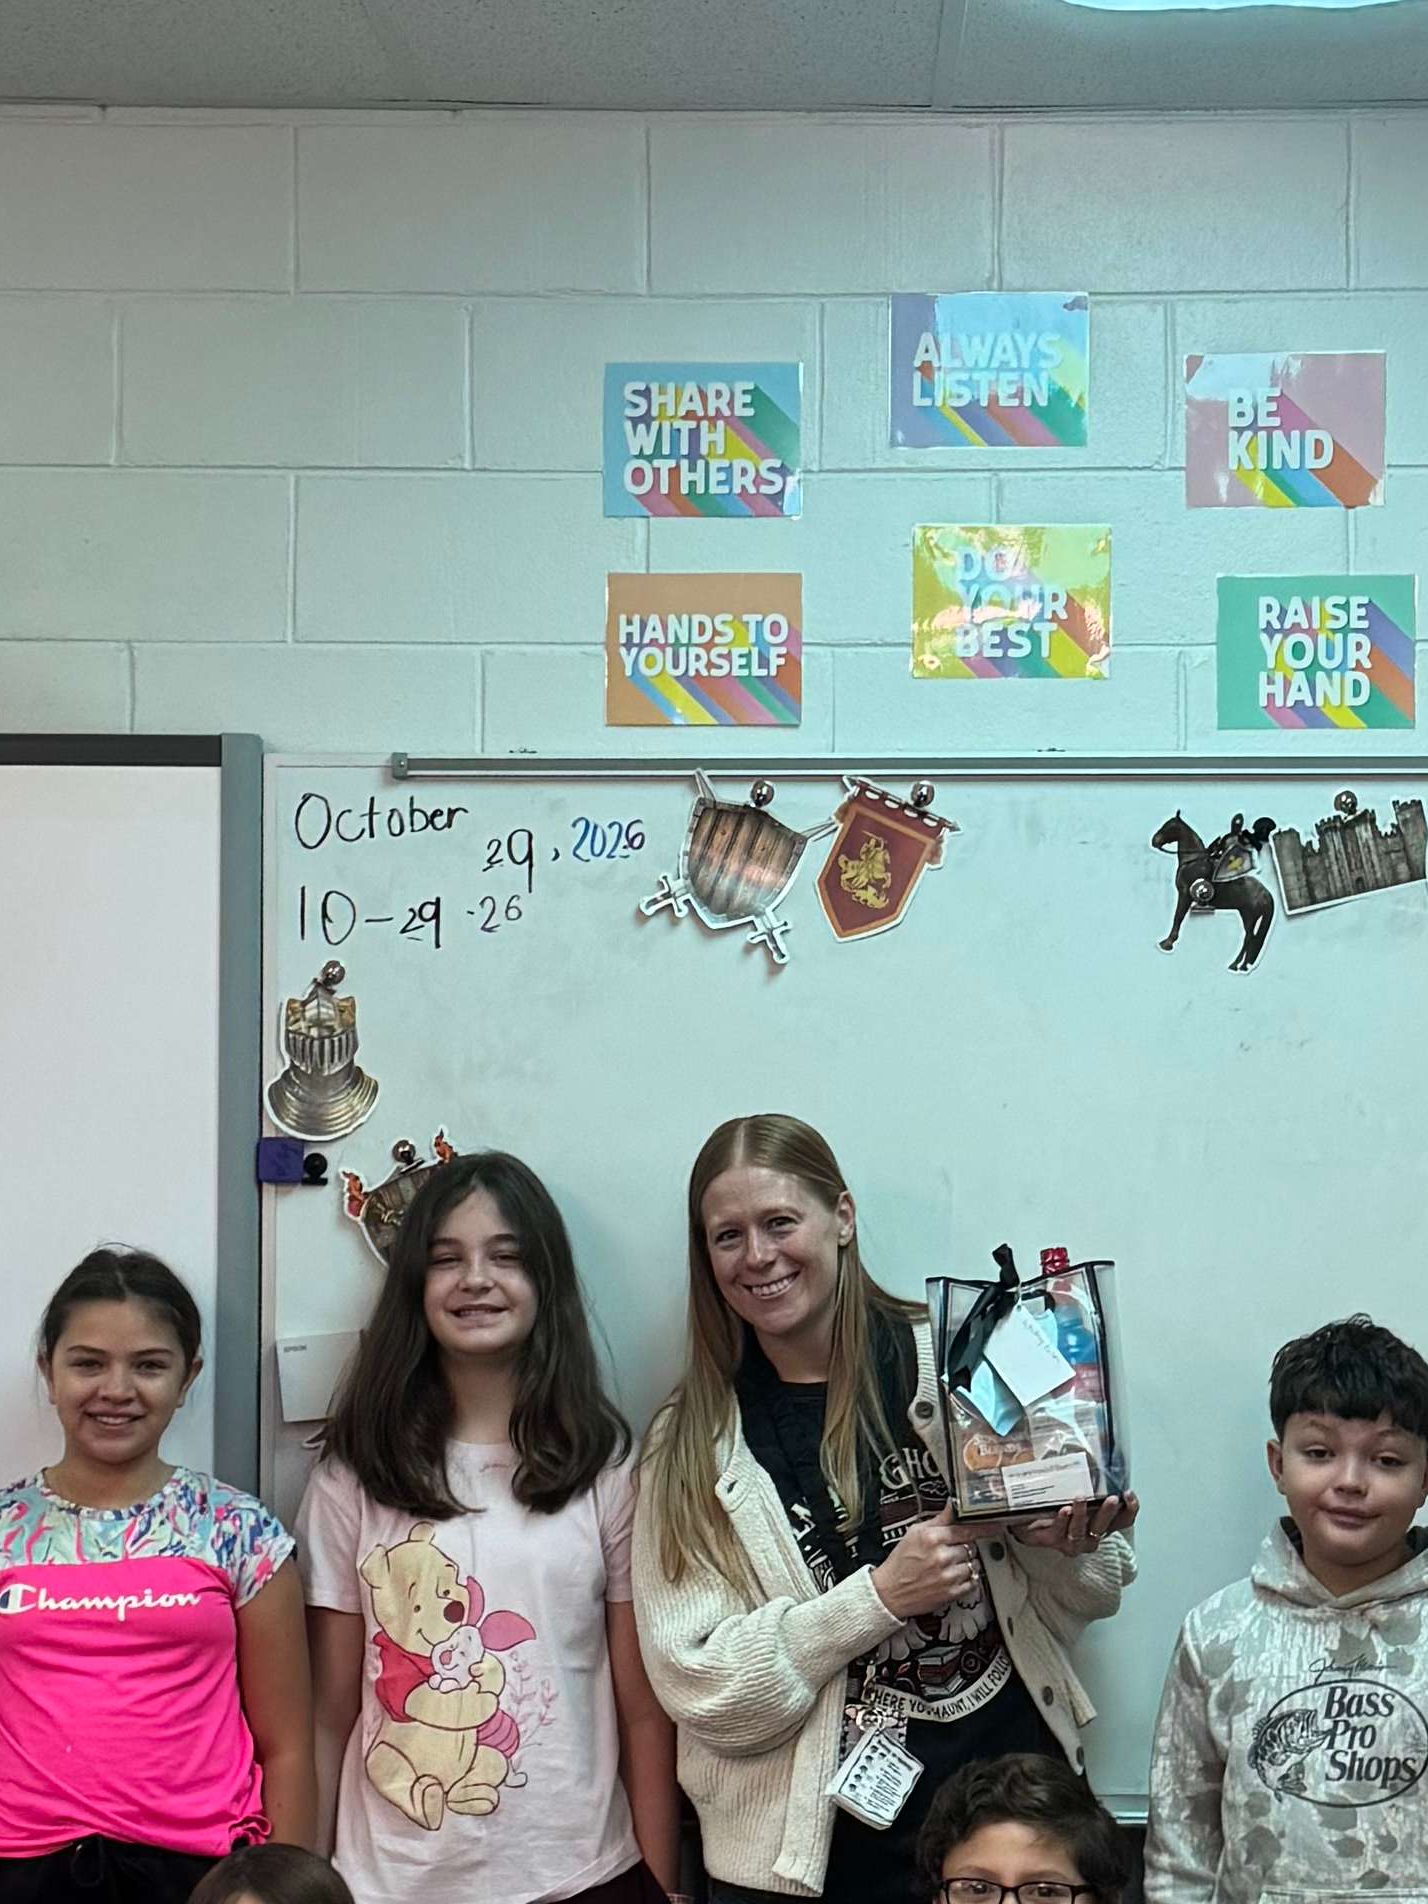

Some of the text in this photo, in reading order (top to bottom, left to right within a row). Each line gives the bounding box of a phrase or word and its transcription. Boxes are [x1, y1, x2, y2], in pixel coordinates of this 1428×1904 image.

[913, 333, 1063, 369] ALWAYS
[623, 382, 756, 418] SHARE
[912, 371, 1050, 408] LISTEN
[1227, 389, 1281, 430] BE
[624, 421, 726, 455] WITH
[1227, 431, 1335, 472] KIND
[623, 460, 786, 496] OTHERS
[959, 551, 1013, 583] DO
[958, 586, 1069, 623] YOUR
[1258, 597, 1371, 632] RAISE
[619, 613, 789, 647] HANDS TO
[954, 623, 1056, 660] BEST
[619, 645, 787, 678] YOURSELF
[1259, 634, 1374, 670] YOUR
[1257, 670, 1372, 708] HAND
[294, 792, 468, 850] October
[571, 816, 646, 863] 2026
[282, 1344, 308, 1354] EPSON
[989, 1653, 1012, 1688] FOLLO
[1323, 1686, 1396, 1720] Bass
[1324, 1720, 1378, 1751] Pro
[1324, 1750, 1418, 1795] Shops
